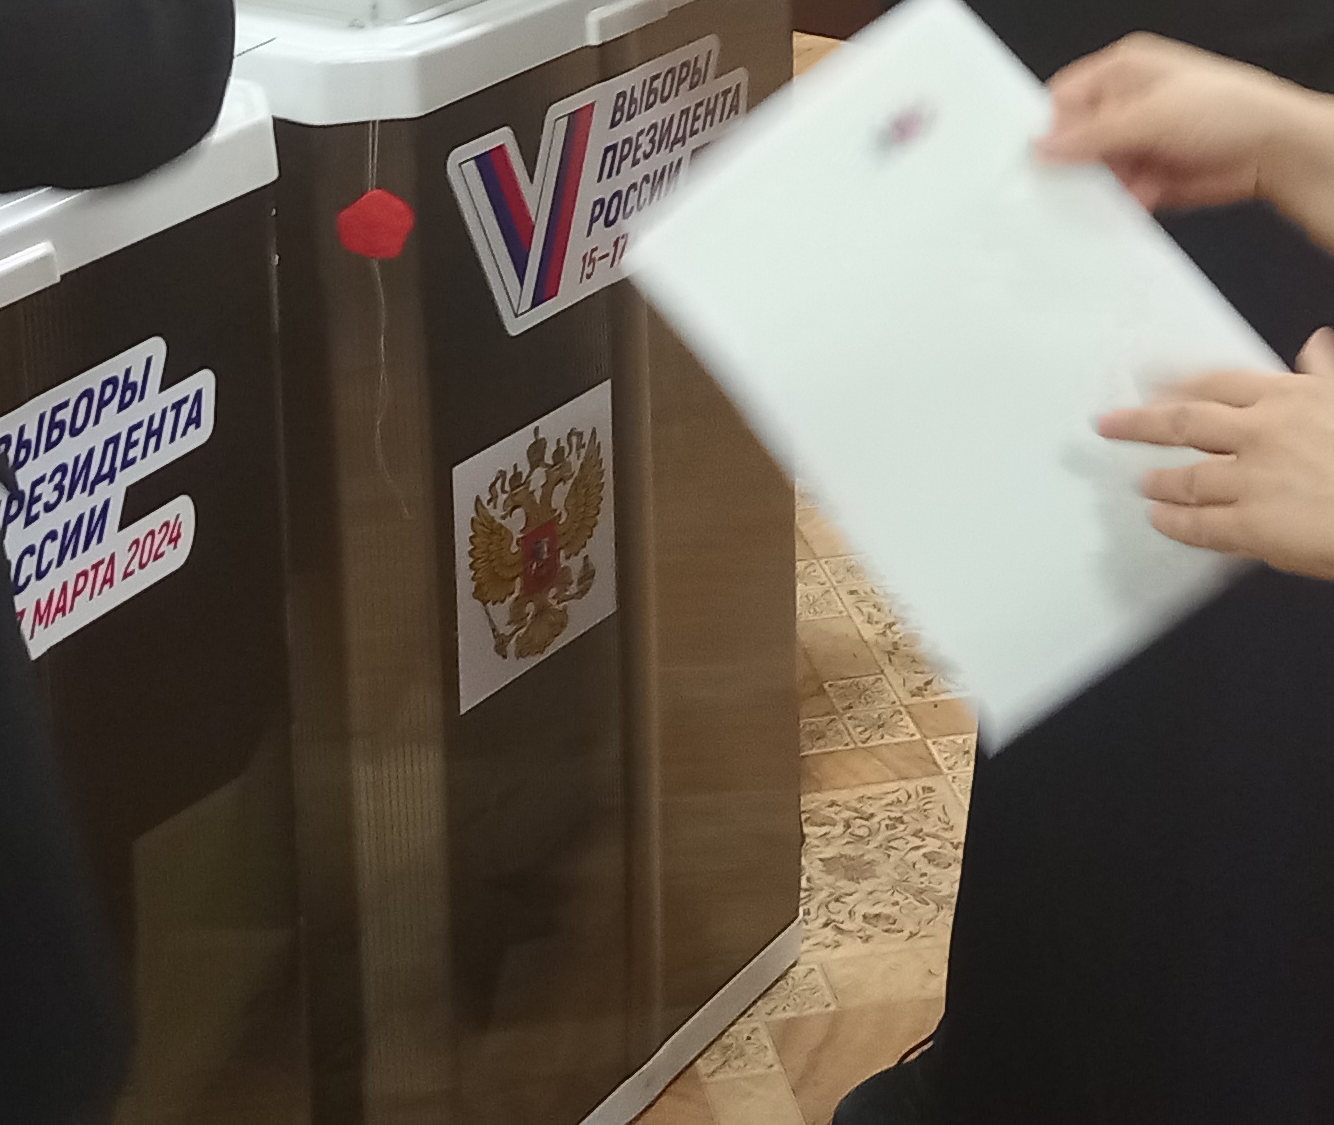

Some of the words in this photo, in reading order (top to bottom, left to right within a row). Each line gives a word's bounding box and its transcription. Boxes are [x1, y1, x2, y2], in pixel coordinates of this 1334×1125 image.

[596, 81, 742, 184] ПРЕЗИДЕНТА
[609, 49, 713, 130] ВЫБОРЫ
[586, 156, 684, 238] РОССИИ
[14, 497, 112, 596] ССИИ
[28, 551, 116, 641] МАРТА
[121, 513, 183, 583] 2024
